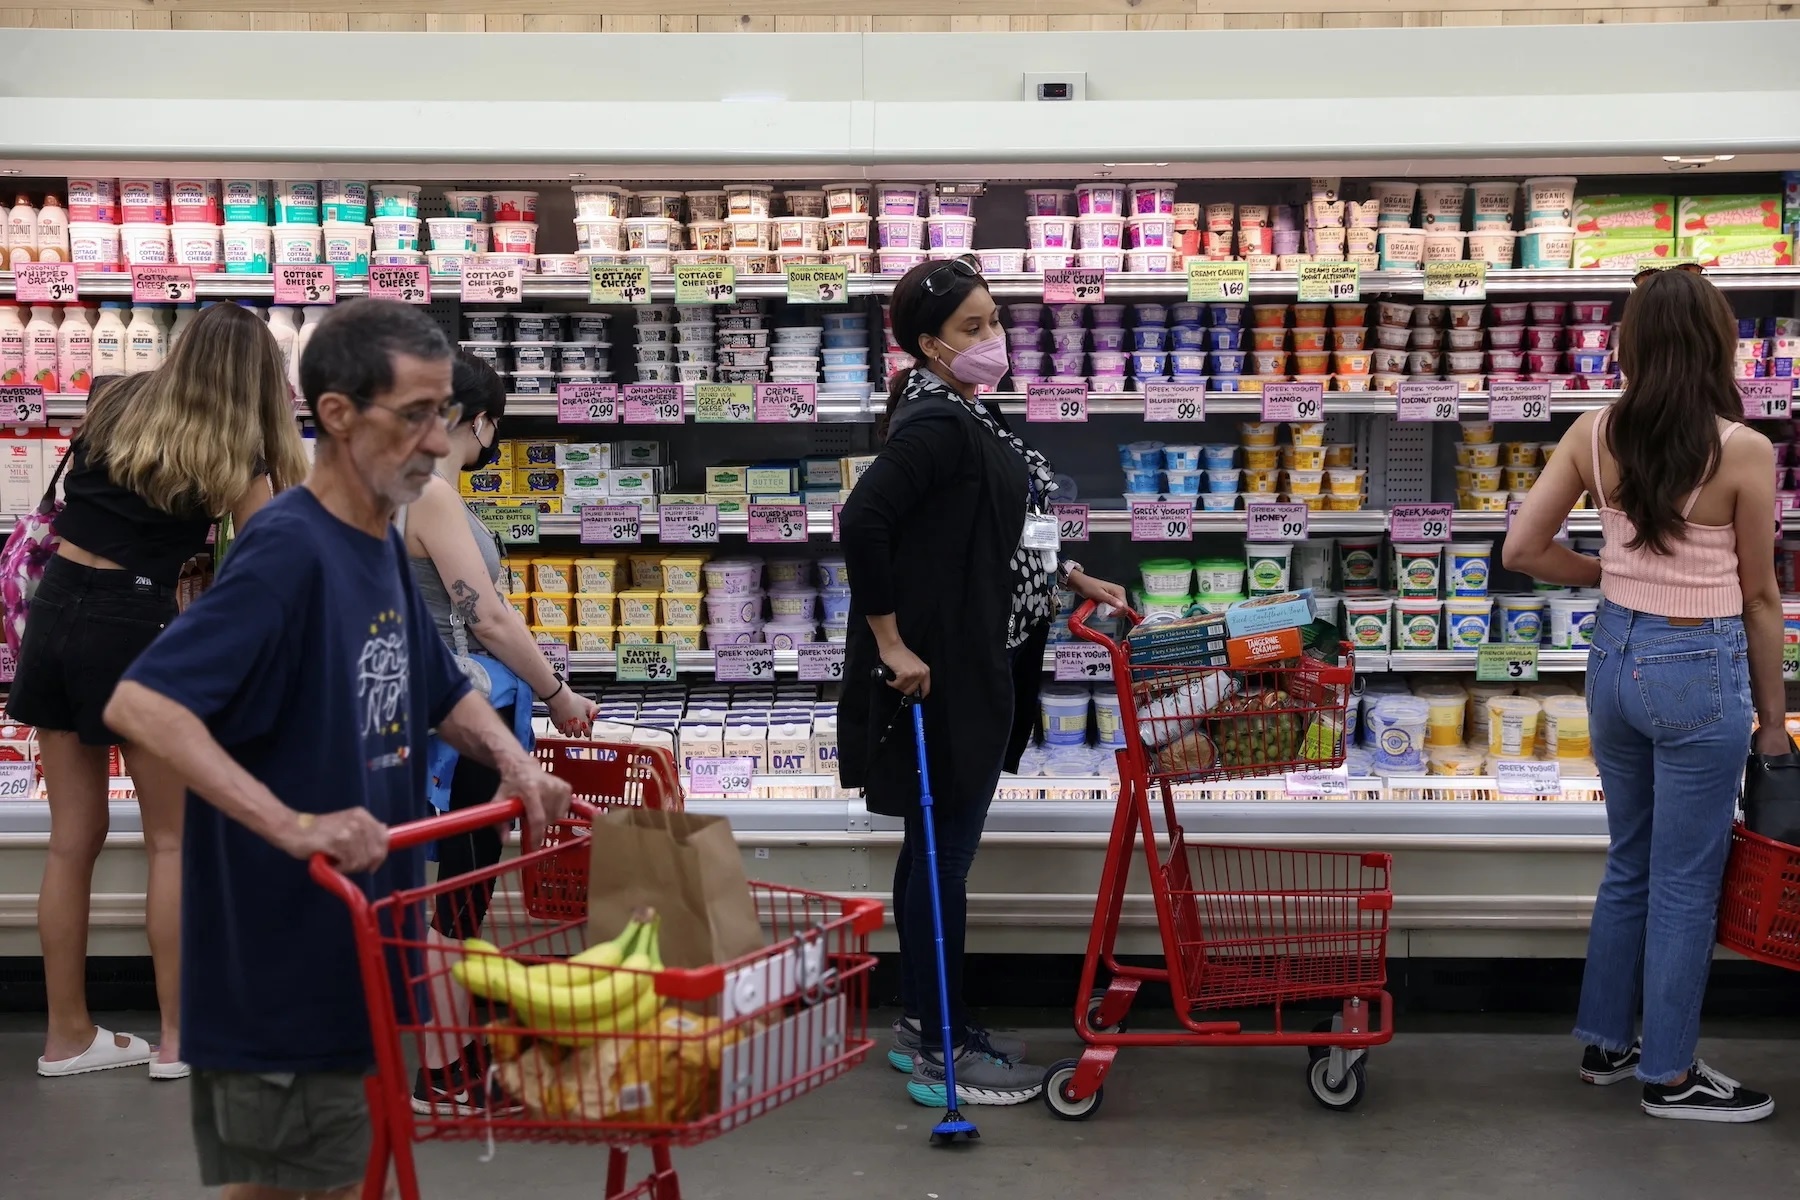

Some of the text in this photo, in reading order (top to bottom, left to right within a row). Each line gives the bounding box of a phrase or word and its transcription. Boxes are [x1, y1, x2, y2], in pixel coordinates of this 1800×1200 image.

[9, 225, 31, 236] COCONUT
[38, 225, 61, 236] COCONUT
[372, 272, 420, 280] COTTAGE
[594, 272, 642, 280] COTTAGE
[790, 272, 844, 281] SOUR CREAM
[1218, 269, 1244, 277] CASHEW
[1323, 272, 1356, 280] ALTERNATIVE
[379, 280, 416, 288] CHEESE
[1045, 275, 1104, 285] SOUR CREAM
[1029, 387, 1085, 396] GREEK YOGURT
[625, 393, 677, 402] CREAM CHEESE
[699, 397, 731, 405] CREAM
[698, 405, 723, 413] CHEESE
[752, 478, 784, 486] BUTTER
[751, 510, 781, 518] CULTURED
[1161, 507, 1190, 515] YOGURT
[1394, 508, 1450, 517] GREEK YOGURT
[1255, 514, 1287, 522] HONEY
[136, 576, 152, 586] ZARA
[1245, 636, 1279, 649] TANGERINE
[626, 650, 660, 658] EARTH
[1252, 646, 1272, 654] CREAM
[1056, 651, 1082, 659] GREEK
[773, 755, 805, 769] OAT
[695, 765, 719, 775] OAT
[923, 1066, 946, 1081] HOK
